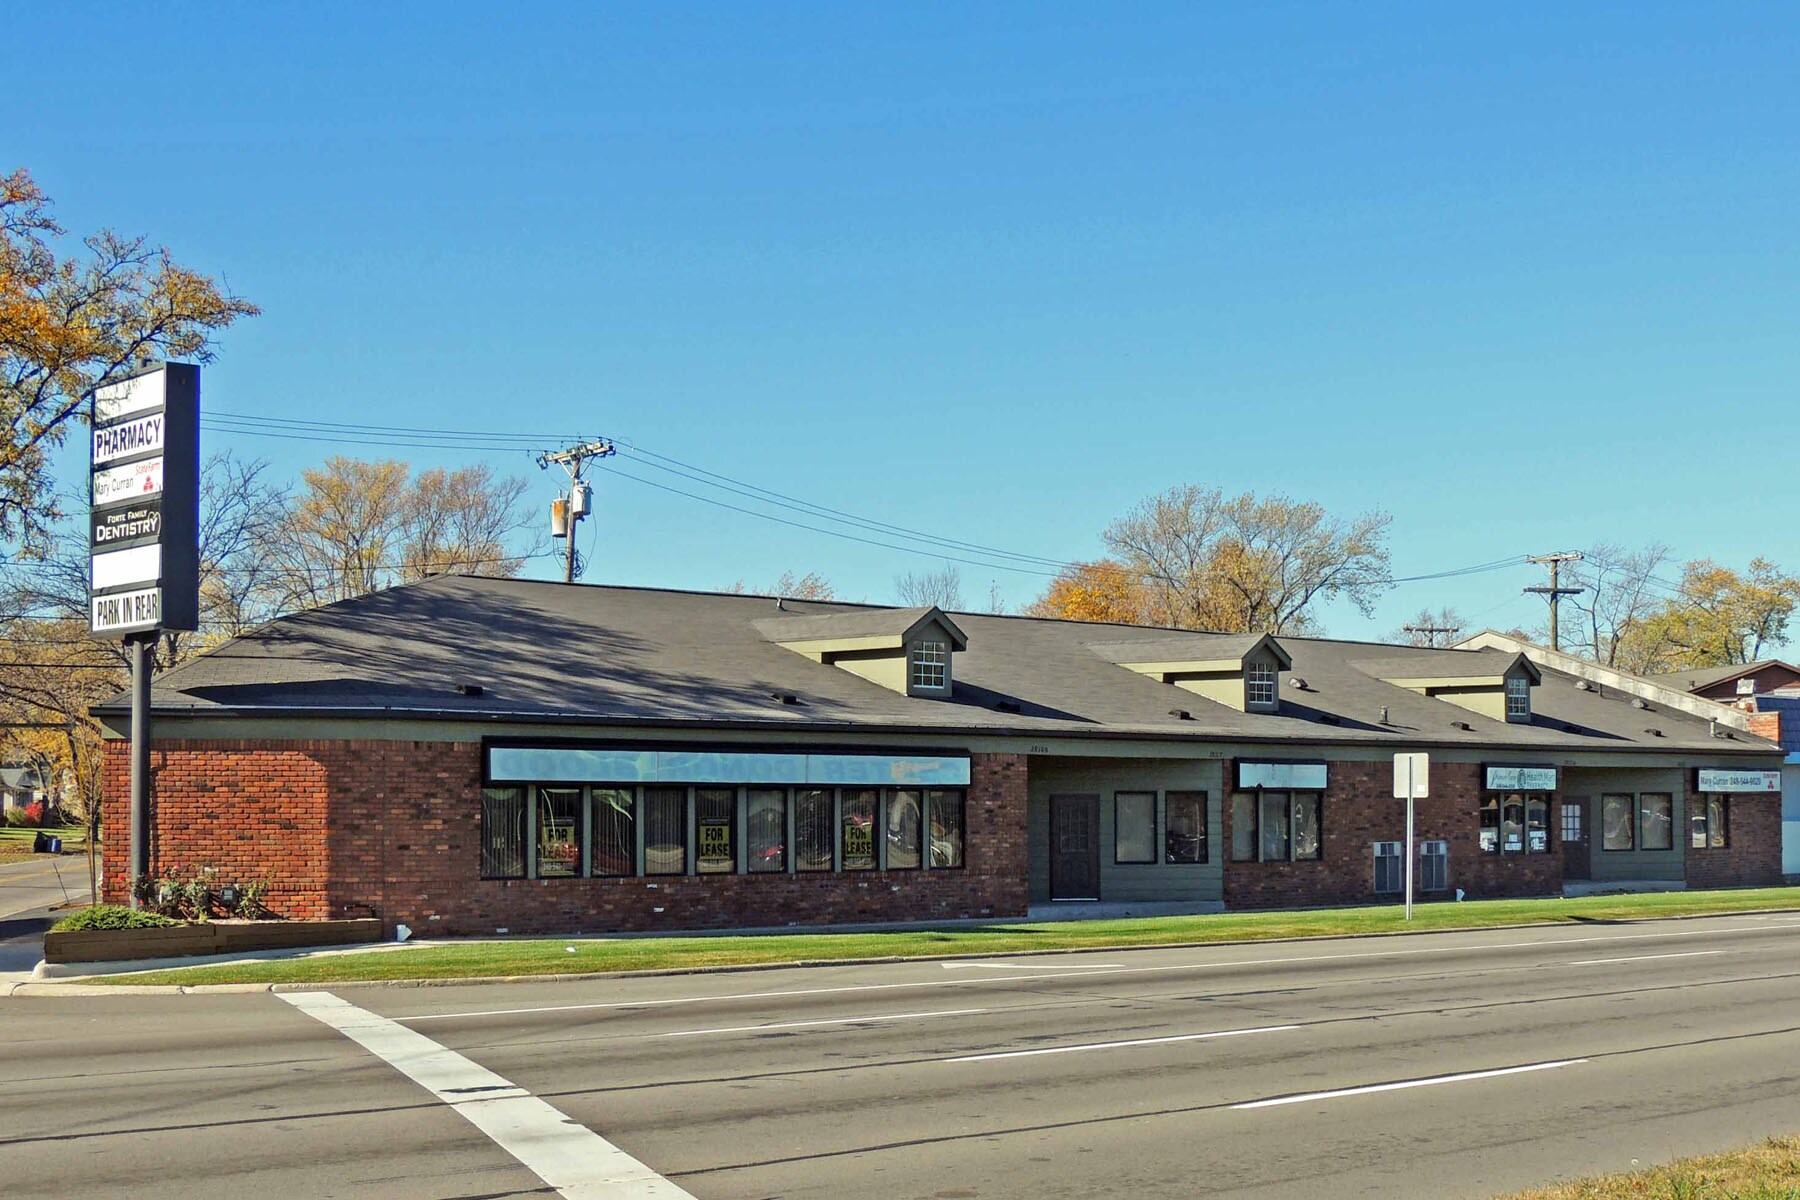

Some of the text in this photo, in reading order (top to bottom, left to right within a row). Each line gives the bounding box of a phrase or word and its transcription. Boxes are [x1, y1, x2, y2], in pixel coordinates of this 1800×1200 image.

[96, 418, 161, 458] PHARMACY
[111, 477, 134, 492] Curran
[96, 517, 158, 542] DENTISTRY
[97, 593, 158, 627] PARK IN REAR
[705, 827, 724, 841] FOR
[700, 843, 729, 857] LEASE
[846, 841, 871, 855] LEASE
